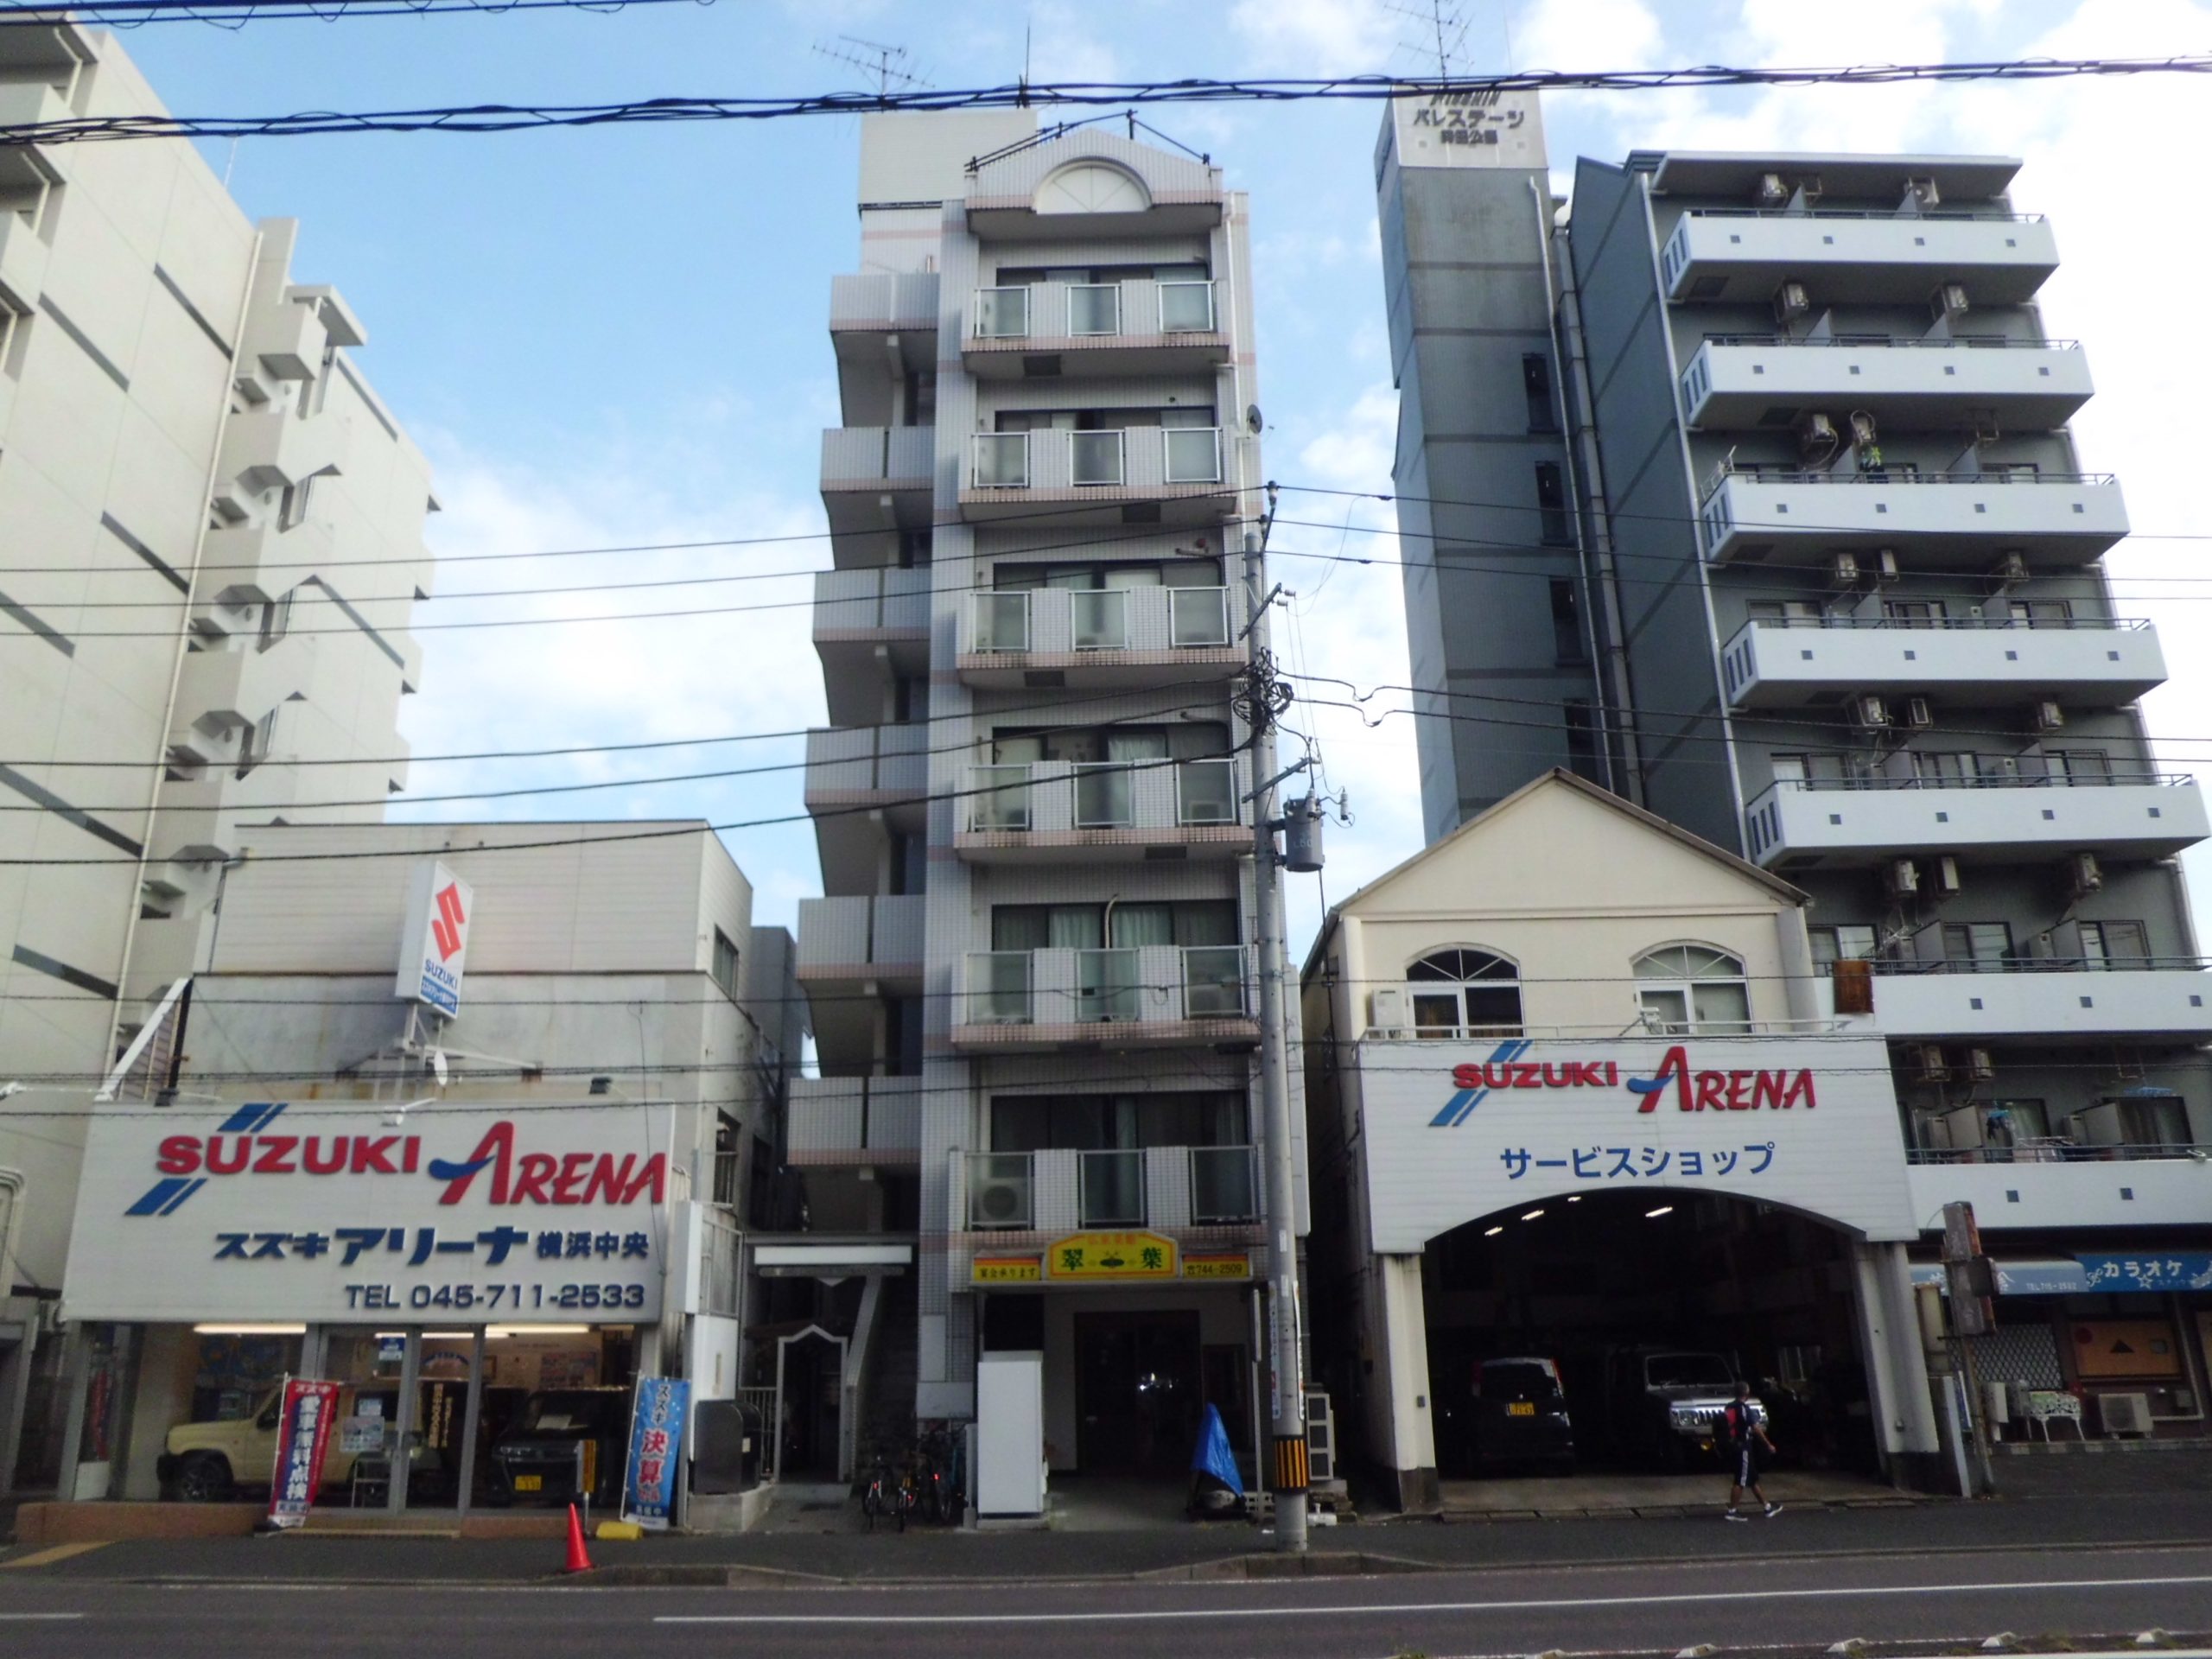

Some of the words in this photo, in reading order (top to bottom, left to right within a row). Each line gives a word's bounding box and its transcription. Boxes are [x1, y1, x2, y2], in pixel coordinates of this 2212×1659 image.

[424, 958, 458, 990] SUZUKI
[1453, 1060, 1618, 1089] SUZUKI
[1627, 1046, 1816, 1113] ARENA
[157, 1135, 421, 1175] SUZUKI
[429, 1121, 666, 1205] ARENA
[1499, 1141, 1776, 1179] サービスショップ
[2103, 1260, 2183, 1277] カラオケ
[346, 1284, 401, 1309] TEL
[411, 1283, 645, 1309] 045-711-2533
